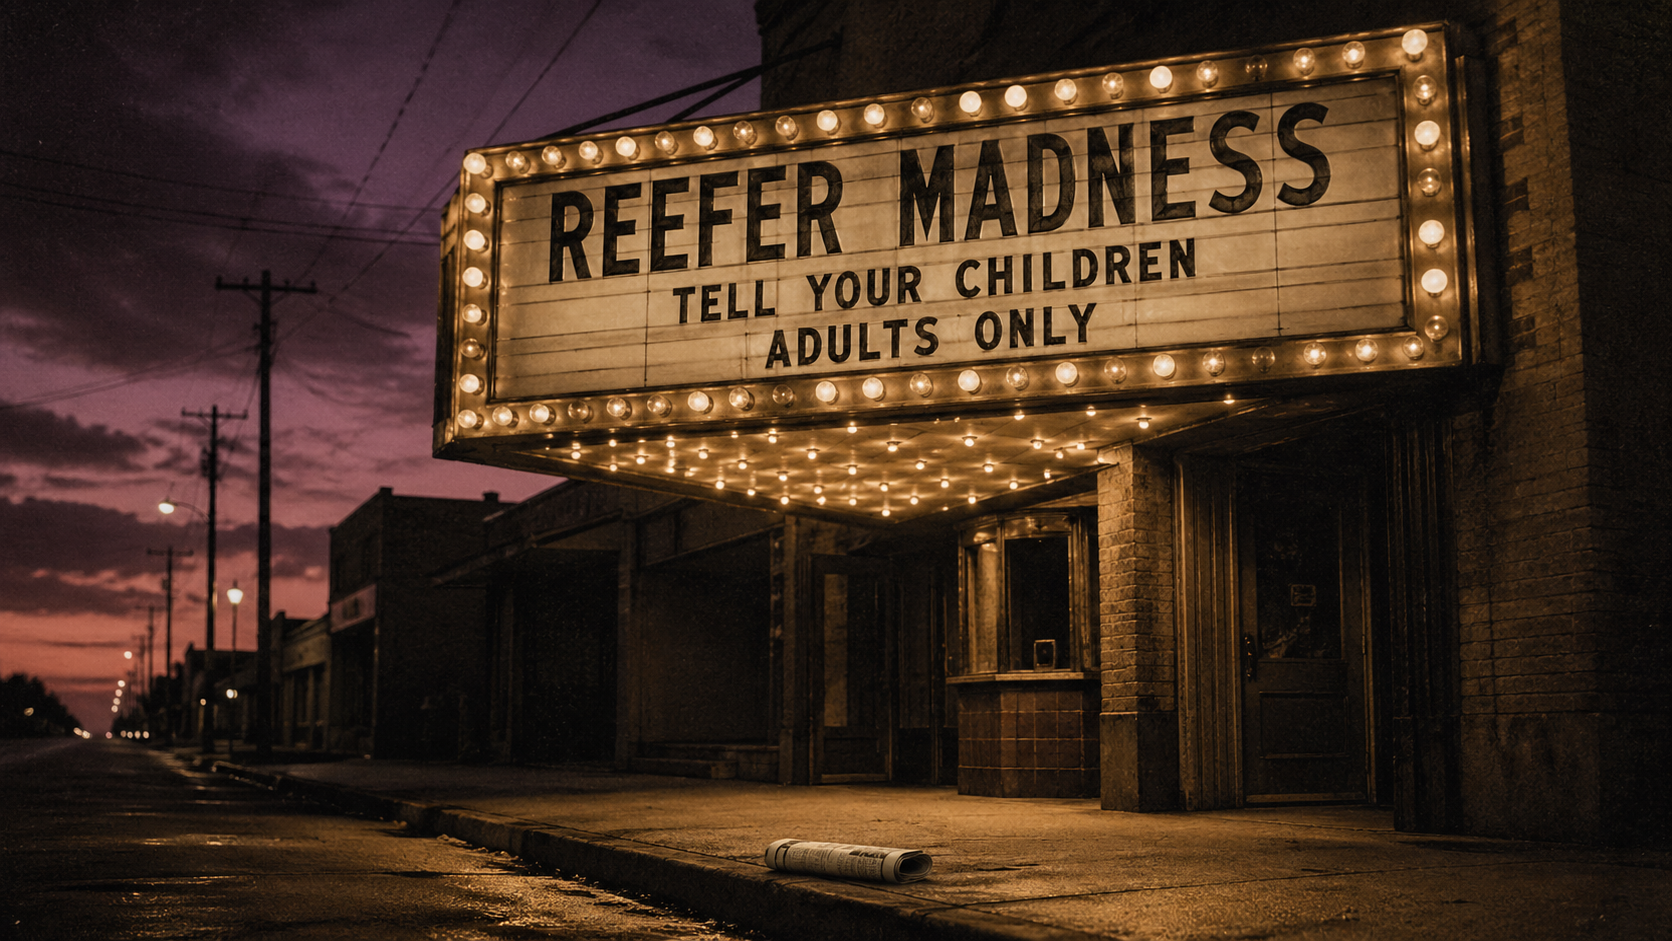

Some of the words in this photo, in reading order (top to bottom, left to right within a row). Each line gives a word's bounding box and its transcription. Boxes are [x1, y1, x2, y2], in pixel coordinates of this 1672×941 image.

[549, 161, 844, 285] REEFER
[899, 102, 1331, 246] MADNESS
[672, 280, 776, 324] TELL
[806, 266, 922, 312] YOUR
[955, 237, 1196, 299] CHILDREN
[765, 316, 939, 369] ADULTS
[974, 303, 1097, 352] ONLY
